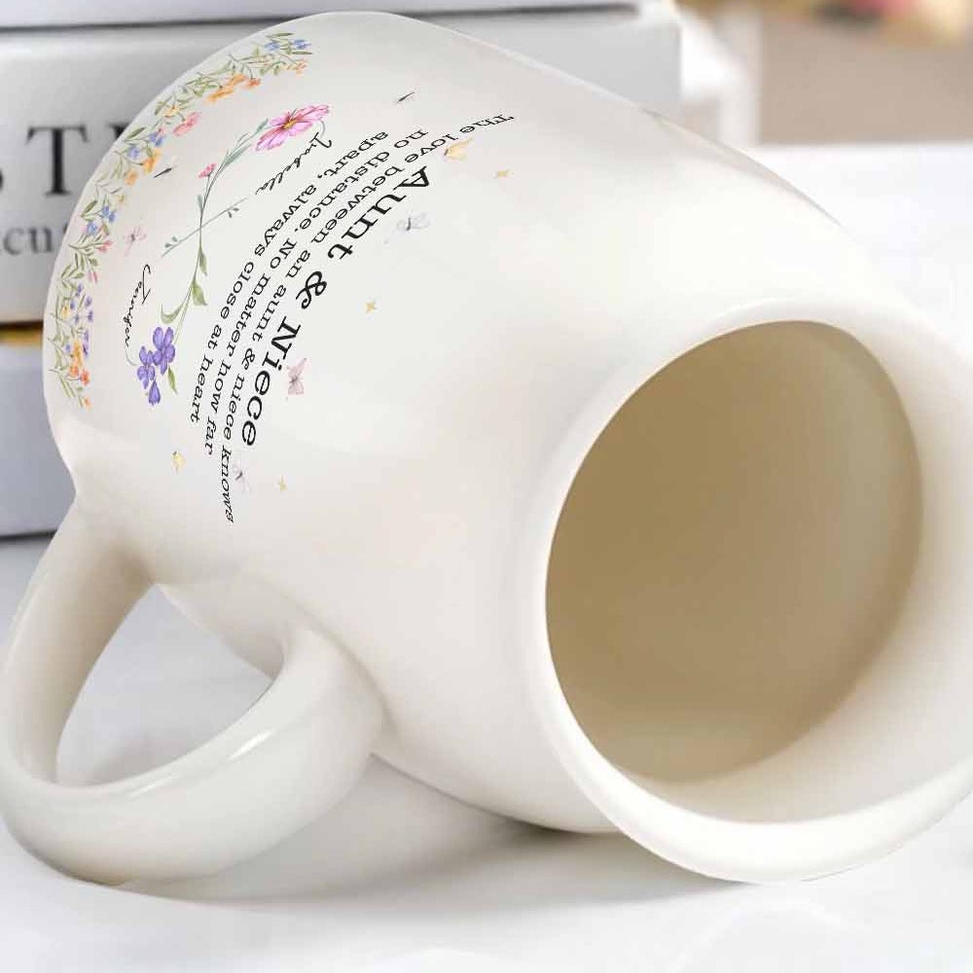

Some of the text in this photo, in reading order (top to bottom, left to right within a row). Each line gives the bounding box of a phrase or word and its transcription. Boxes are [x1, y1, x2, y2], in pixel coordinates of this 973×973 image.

[189, 130, 390, 423] apart, always close at heart
[204, 129, 429, 456] no distance. No matter how far
[219, 113, 515, 524] The love between an aunt & niece knows
[241, 165, 431, 447] Aunt & Niece
